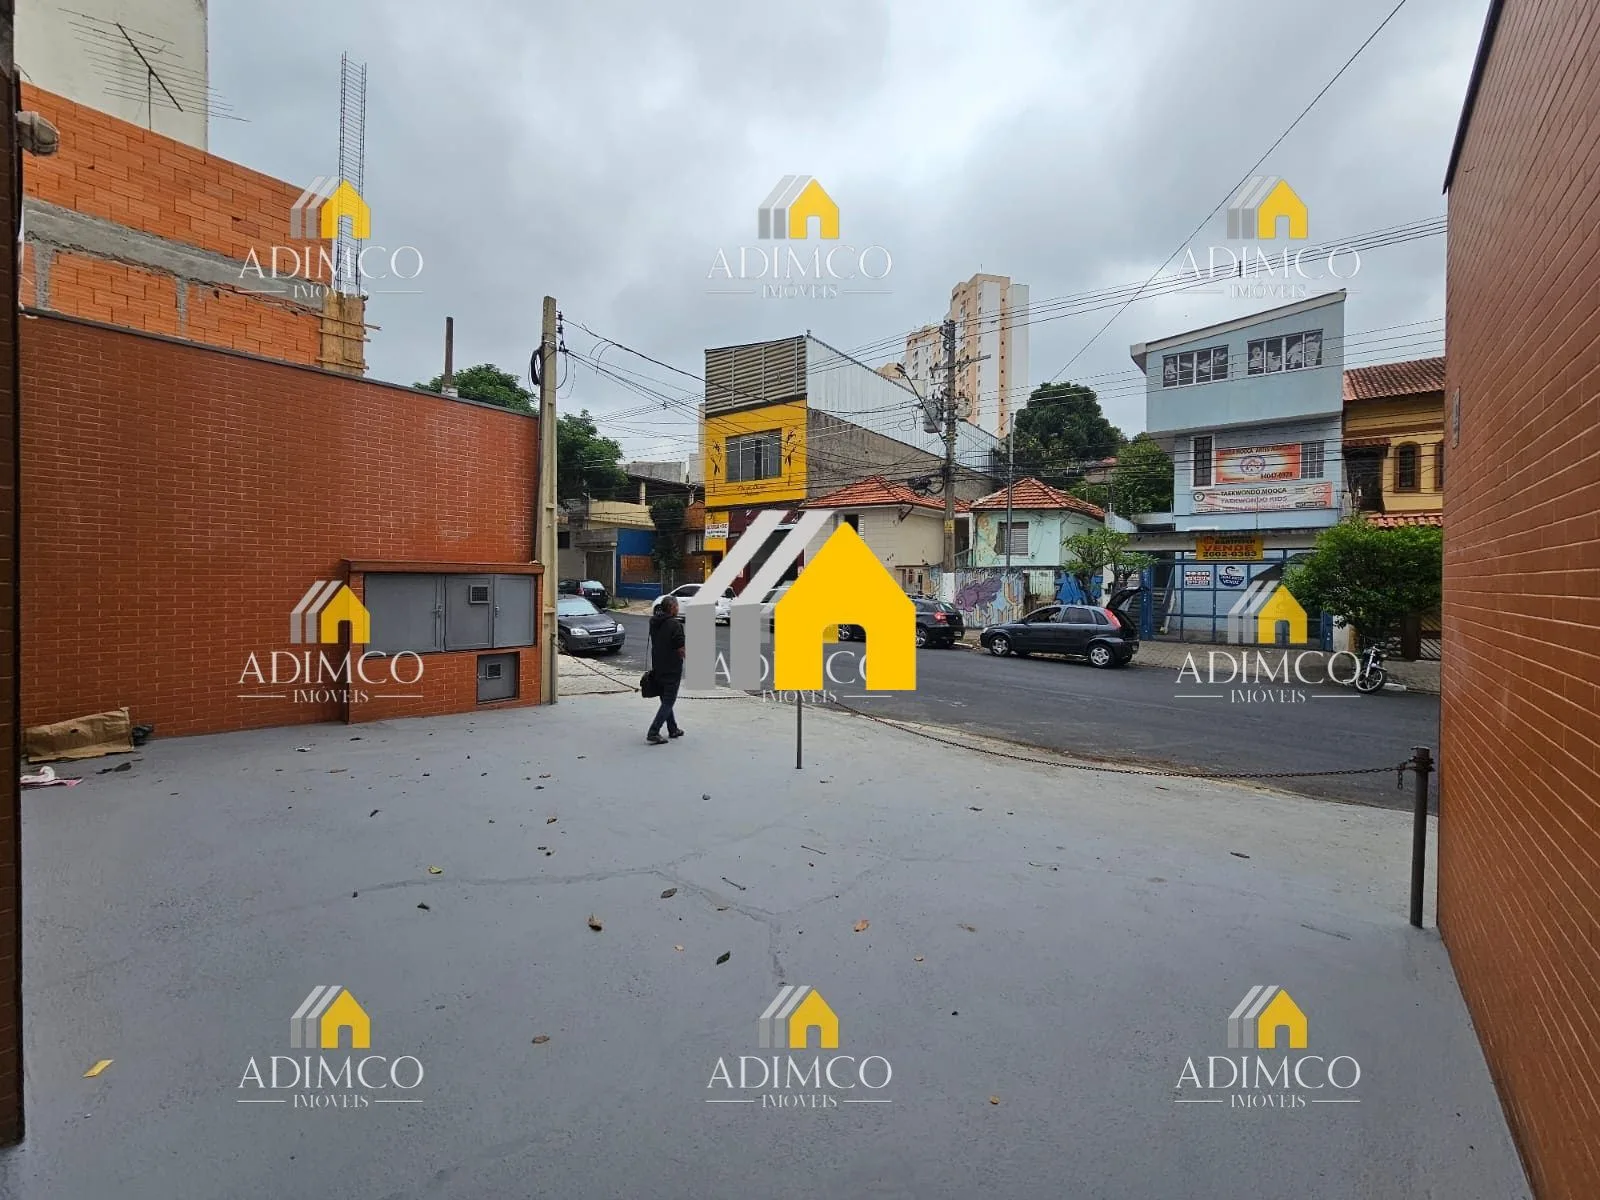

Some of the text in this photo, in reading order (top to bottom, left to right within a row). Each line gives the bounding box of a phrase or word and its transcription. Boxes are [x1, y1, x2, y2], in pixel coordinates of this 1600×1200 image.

[1220, 488, 1260, 496] TAEKWONDO
[1261, 487, 1288, 495] MOOCA
[1203, 544, 1255, 552] VENDE
